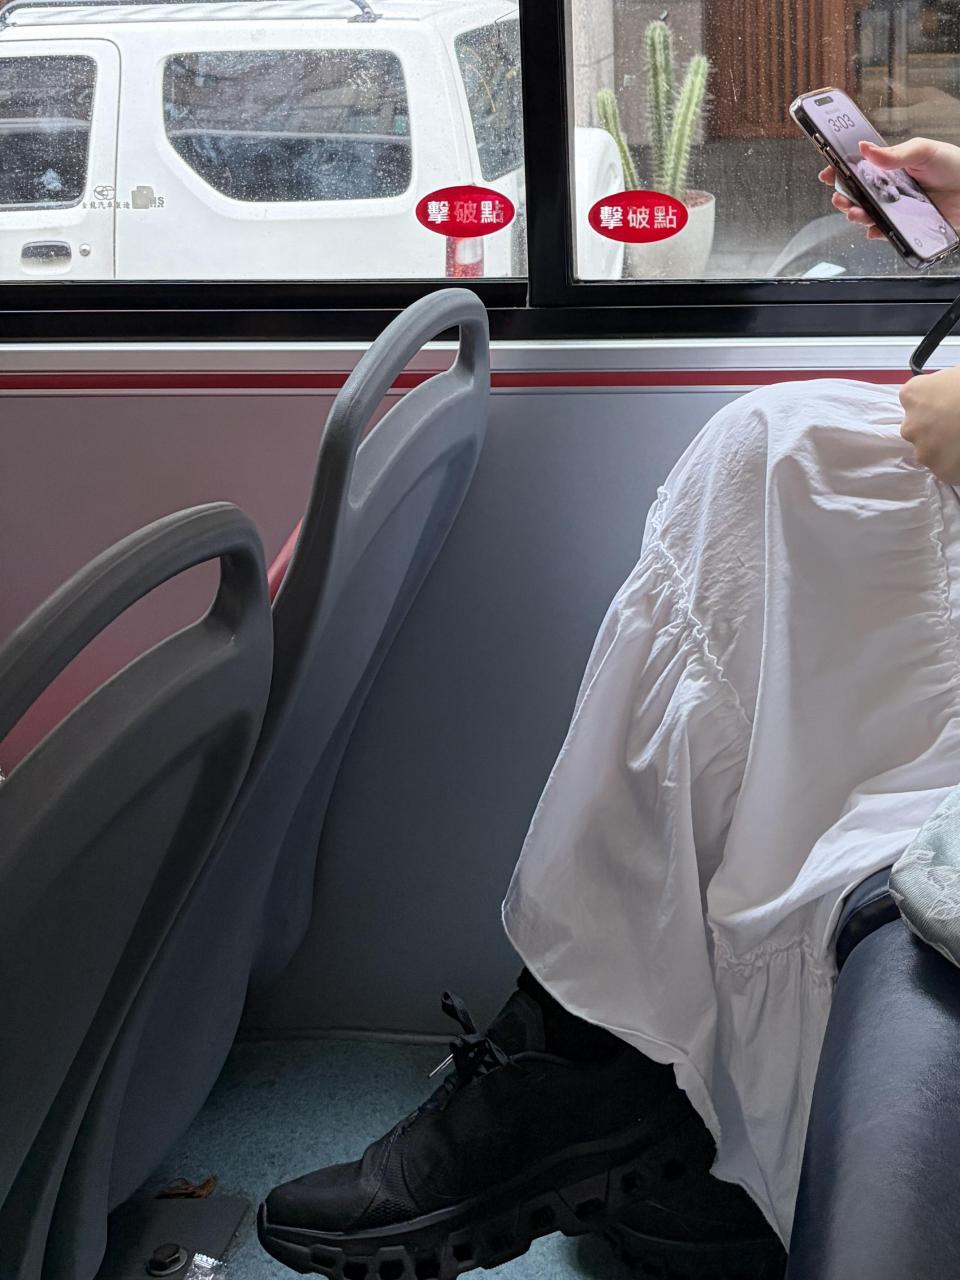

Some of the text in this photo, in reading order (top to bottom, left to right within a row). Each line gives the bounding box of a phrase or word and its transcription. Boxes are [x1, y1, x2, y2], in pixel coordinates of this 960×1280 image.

[828, 113, 856, 133] 3:03
[427, 200, 505, 224] 擊破點
[600, 205, 678, 230] 擊破點
